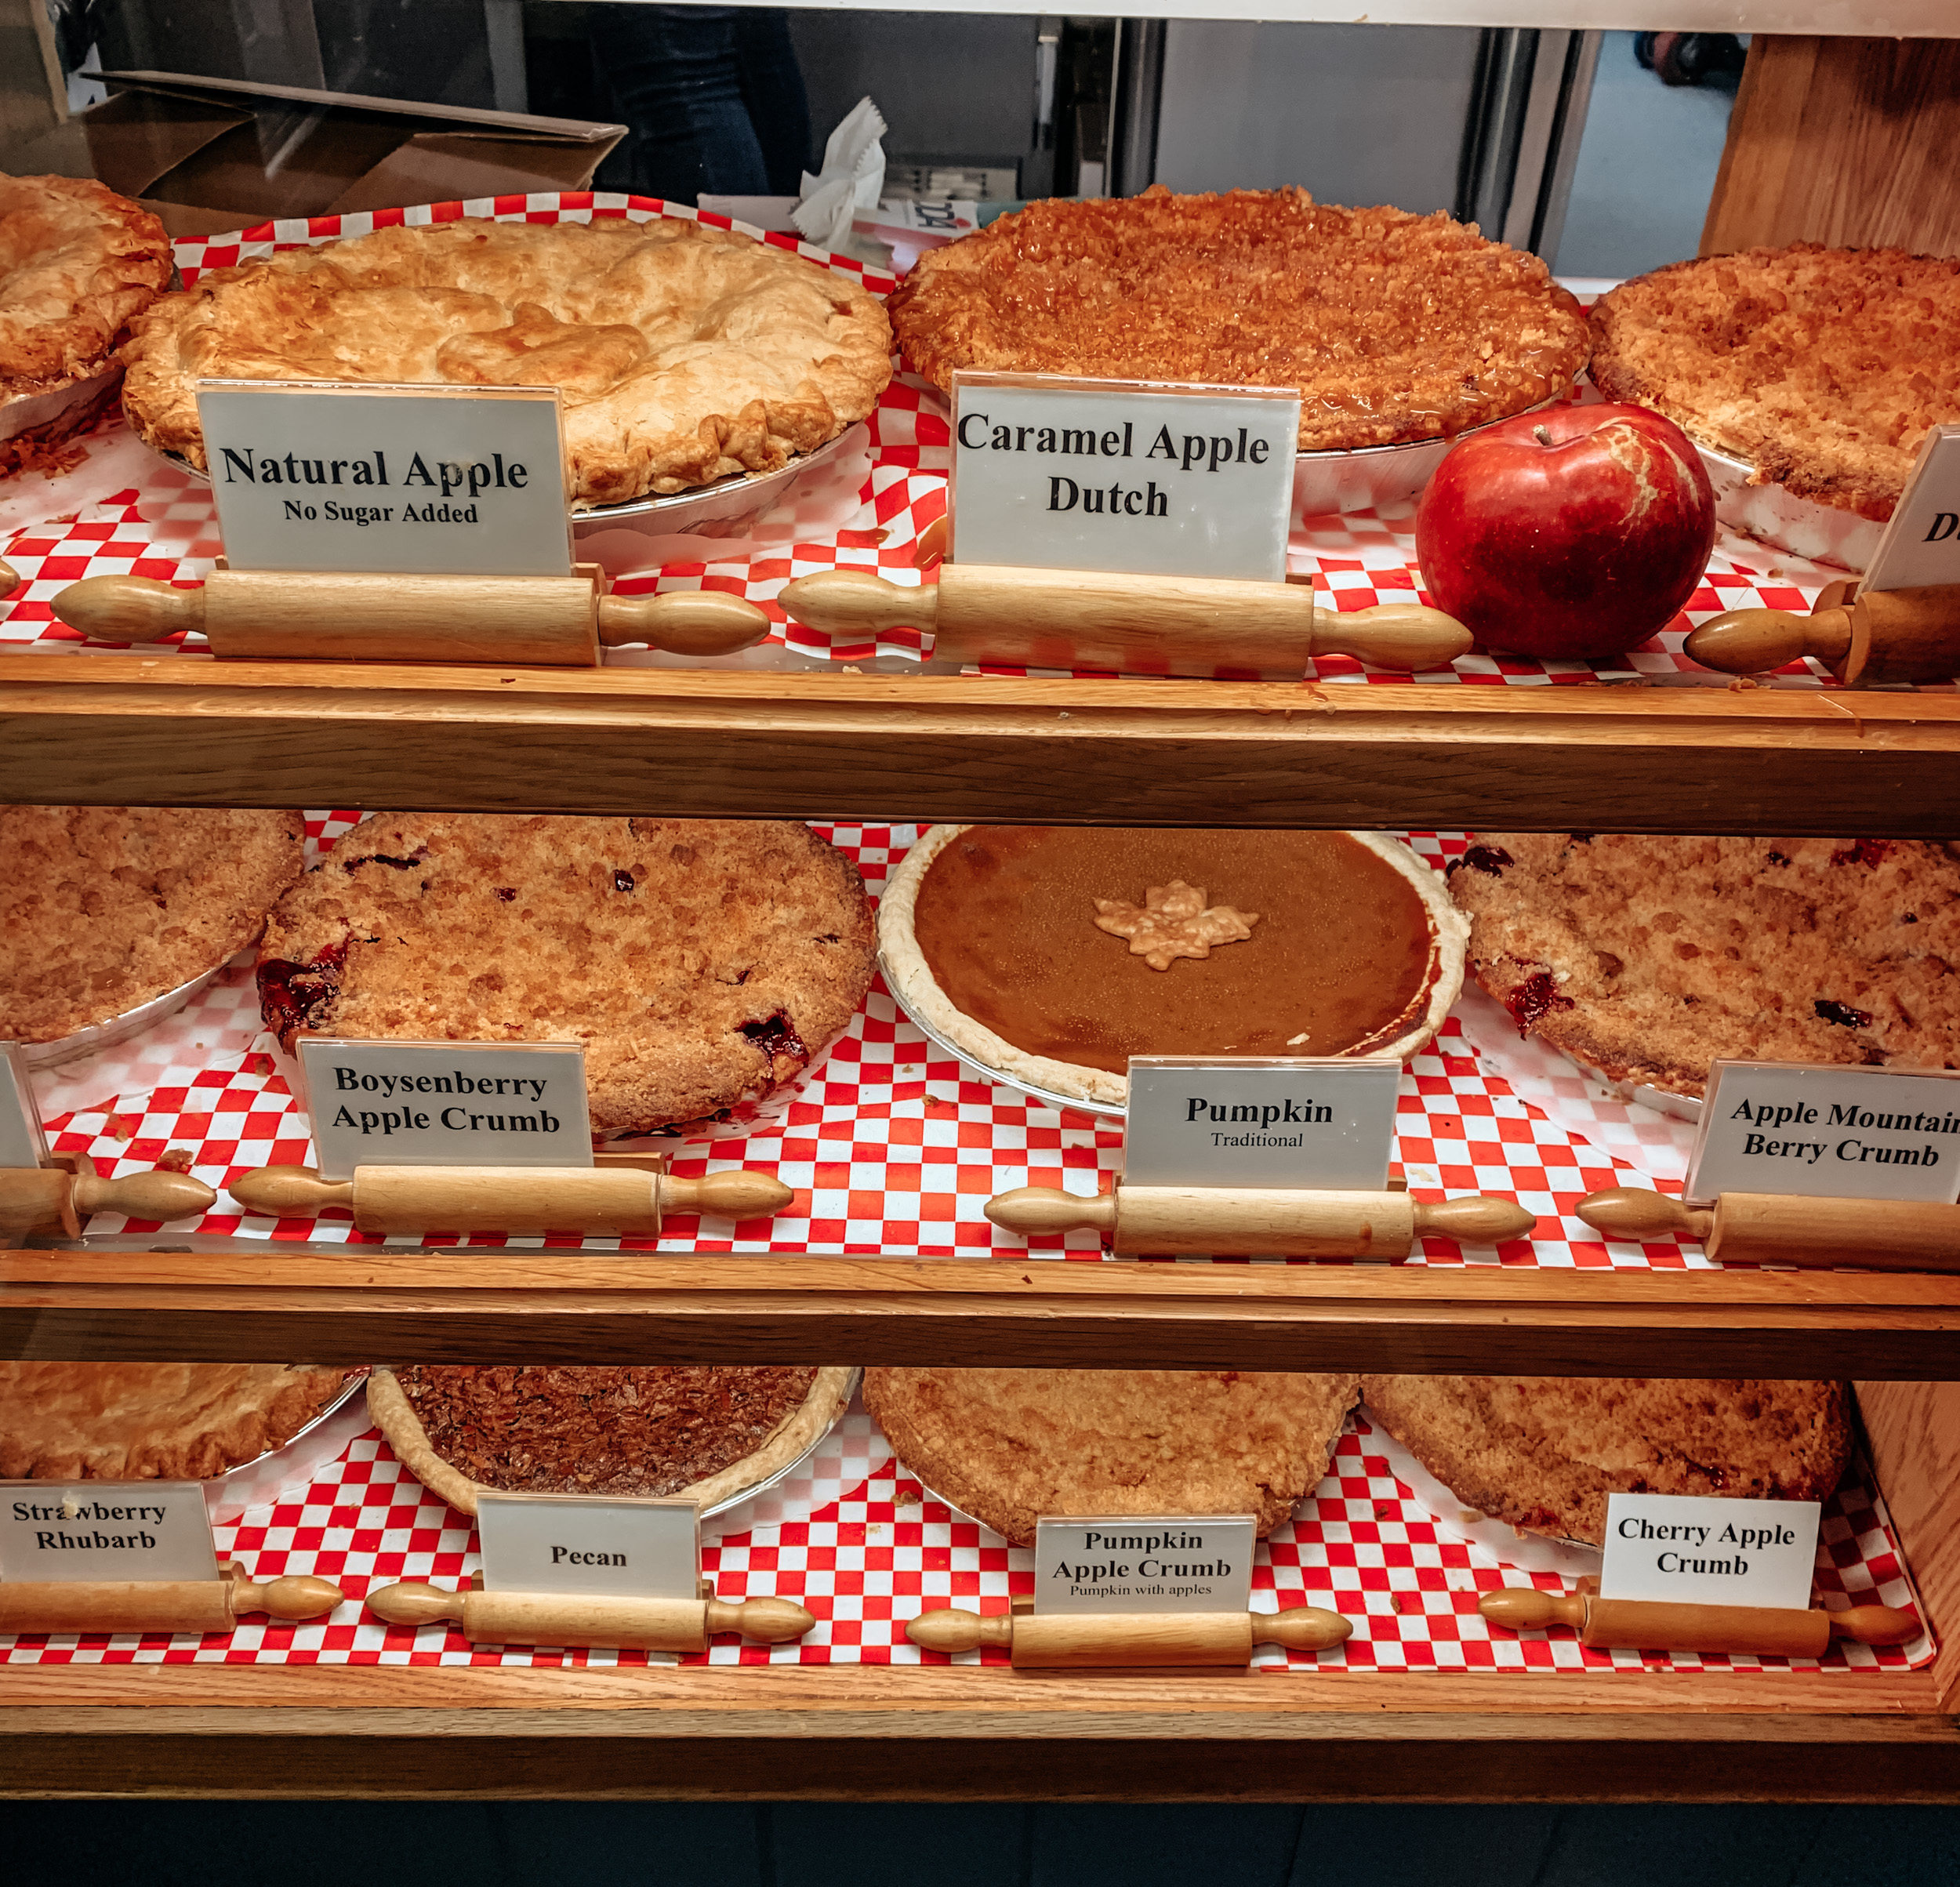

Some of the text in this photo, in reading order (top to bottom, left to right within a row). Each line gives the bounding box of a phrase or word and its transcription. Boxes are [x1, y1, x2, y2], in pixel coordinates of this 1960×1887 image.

[955, 410, 1269, 473] Caramel Apple
[219, 448, 528, 498] Natural Apple
[1045, 476, 1169, 517] Dutch
[281, 500, 479, 527] No Sugar Added
[1921, 512, 1960, 543] D
[332, 1067, 548, 1102] Boysenberry
[332, 1104, 560, 1135] Apple Crumb
[1185, 1098, 1333, 1130] Pumpkin
[1730, 1098, 1819, 1129] Apple
[1210, 1132, 1303, 1147] Traditional
[1742, 1133, 1940, 1167] Berry Crumb
[34, 1530, 156, 1550] Rhubarb
[1084, 1531, 1203, 1555] Pumpkin
[1618, 1518, 1795, 1550] Cherry Apple
[550, 1546, 627, 1567] Pecan
[1052, 1559, 1232, 1584] Apple Crumb
[1657, 1552, 1748, 1576] Crumb
[1070, 1584, 1212, 1599] Pumpkin with apples
